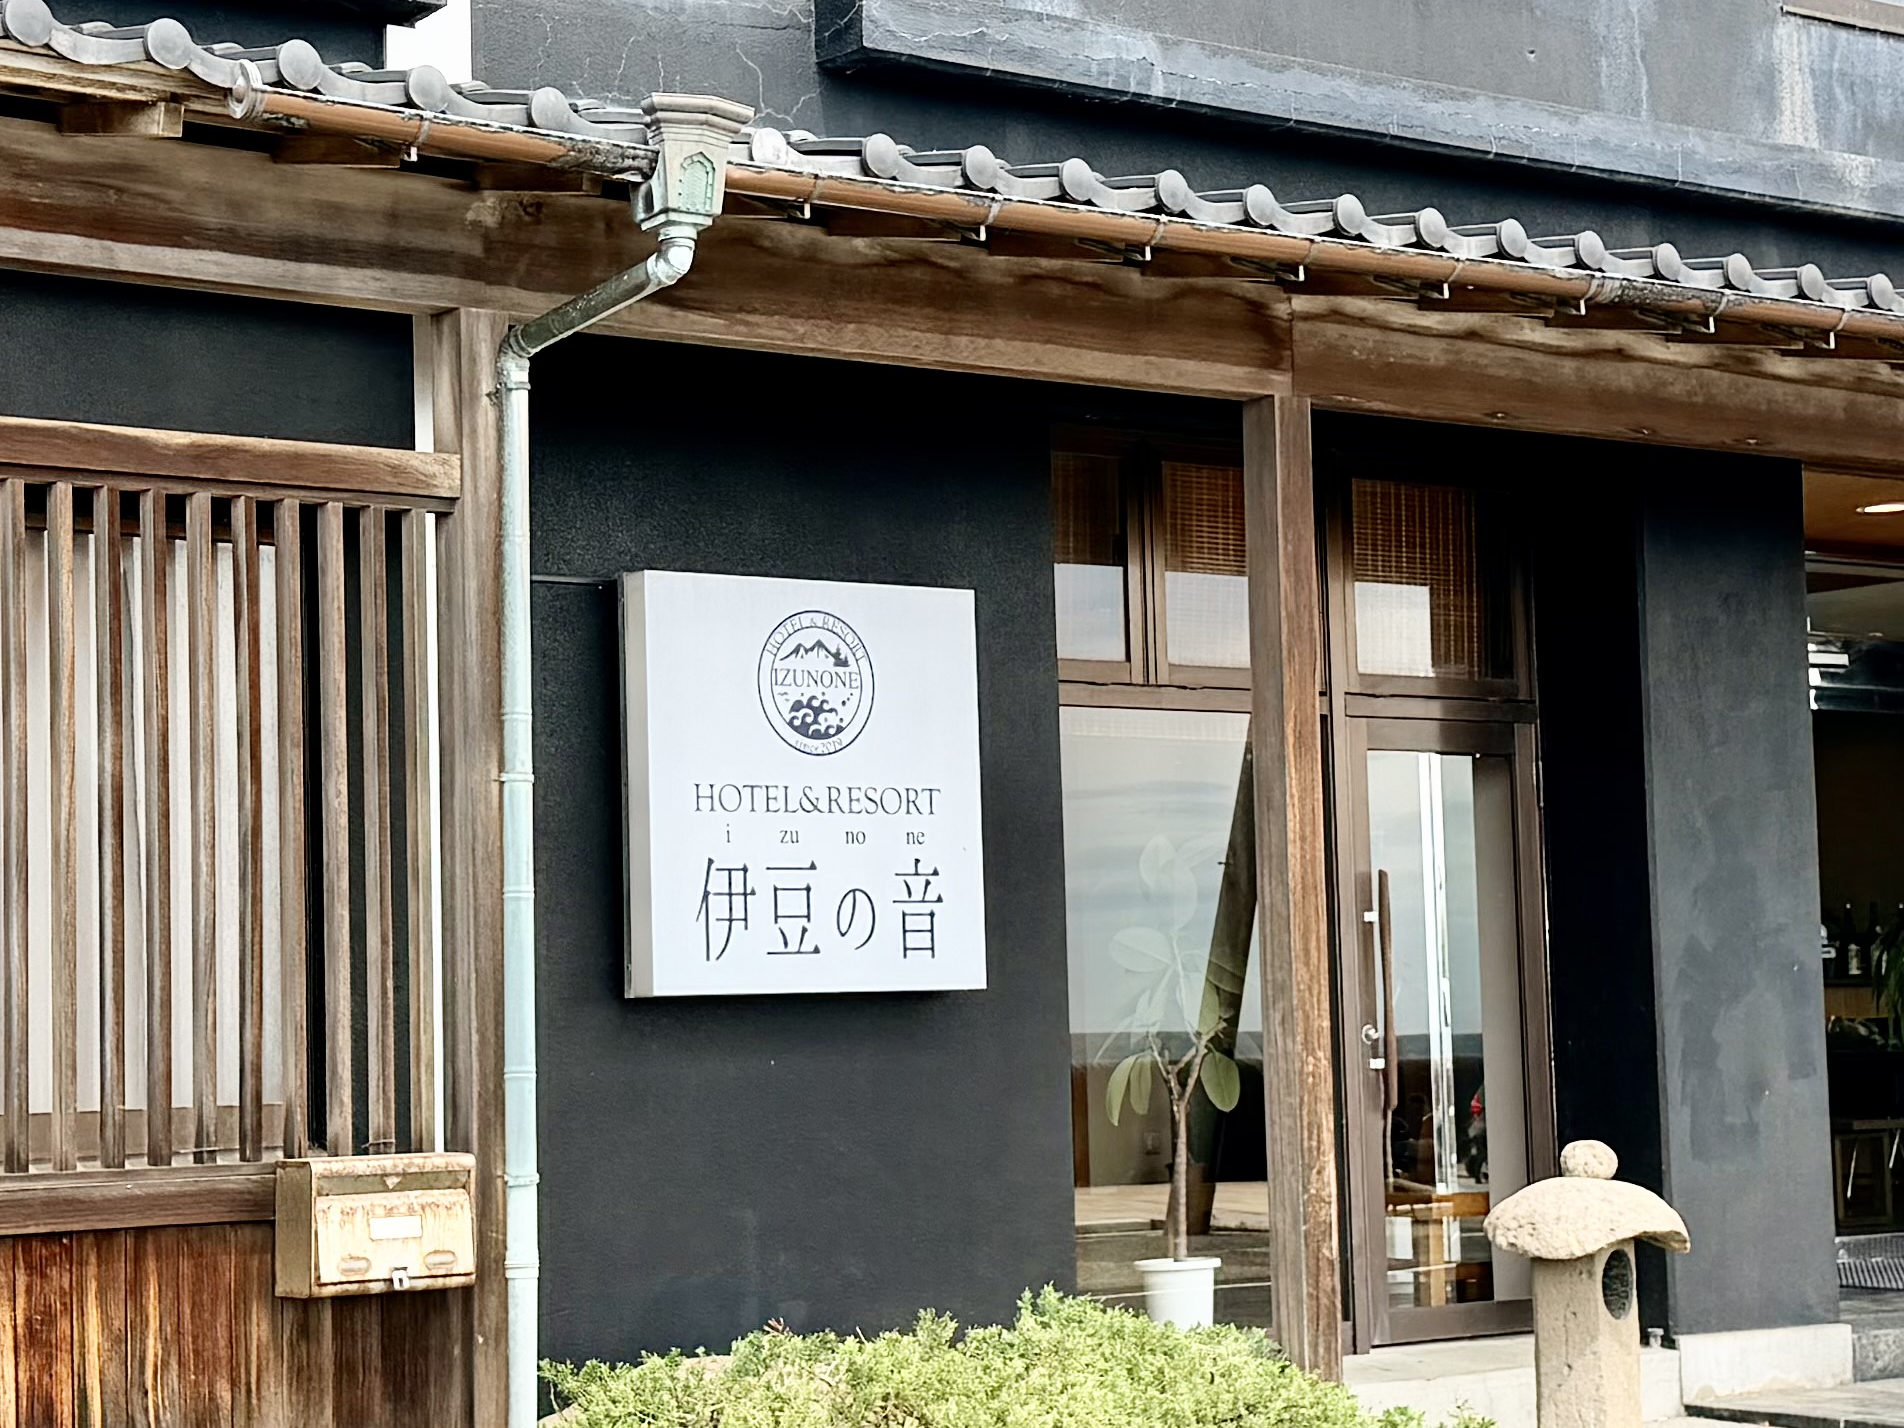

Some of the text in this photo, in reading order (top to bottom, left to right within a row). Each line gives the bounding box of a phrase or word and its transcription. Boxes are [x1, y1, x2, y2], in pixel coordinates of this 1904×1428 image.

[773, 667, 860, 690] IZUNONE
[693, 783, 942, 816] HOTEL&RESORT
[779, 829, 800, 845] zu
[845, 830, 866, 845] no
[906, 831, 926, 846] ne
[695, 856, 944, 962] 伊豆の音
